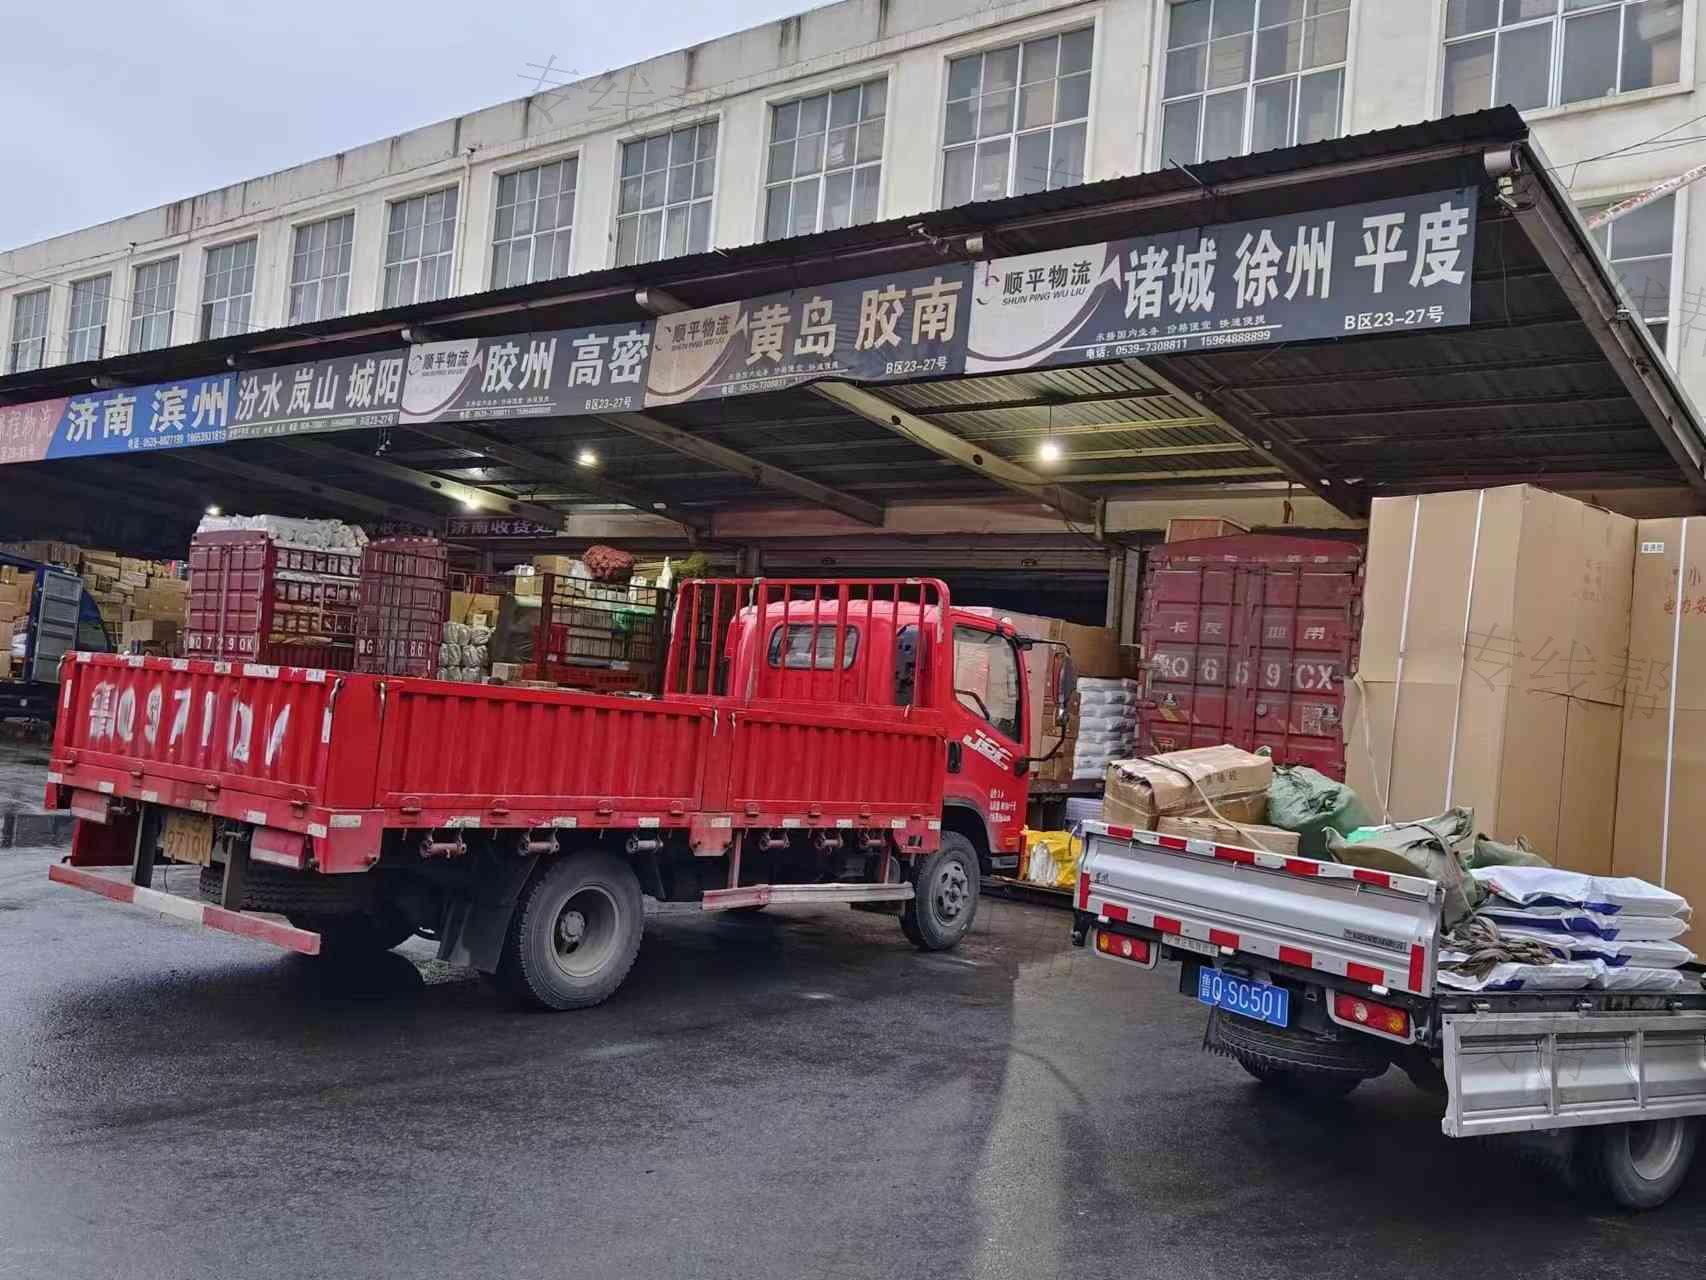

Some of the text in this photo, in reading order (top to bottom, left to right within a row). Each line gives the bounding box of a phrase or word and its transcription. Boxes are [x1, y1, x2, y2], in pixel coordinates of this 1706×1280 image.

[1003, 260, 1093, 296] 顺平物流
[1123, 201, 1470, 320] 诸城 徐州 平度
[746, 276, 963, 364] 黄岛 胶南
[1001, 287, 1086, 306] SHUN PING WU LIU
[1344, 305, 1445, 330] B区23-27号
[672, 315, 732, 343] 顺平物流
[1115, 339, 1188, 355] 0539-7308811
[480, 329, 651, 393] 胶州 高密
[66, 393, 136, 442] 济南
[149, 378, 230, 433] 滨州
[234, 358, 404, 421] 汾水 岚山 城阳
